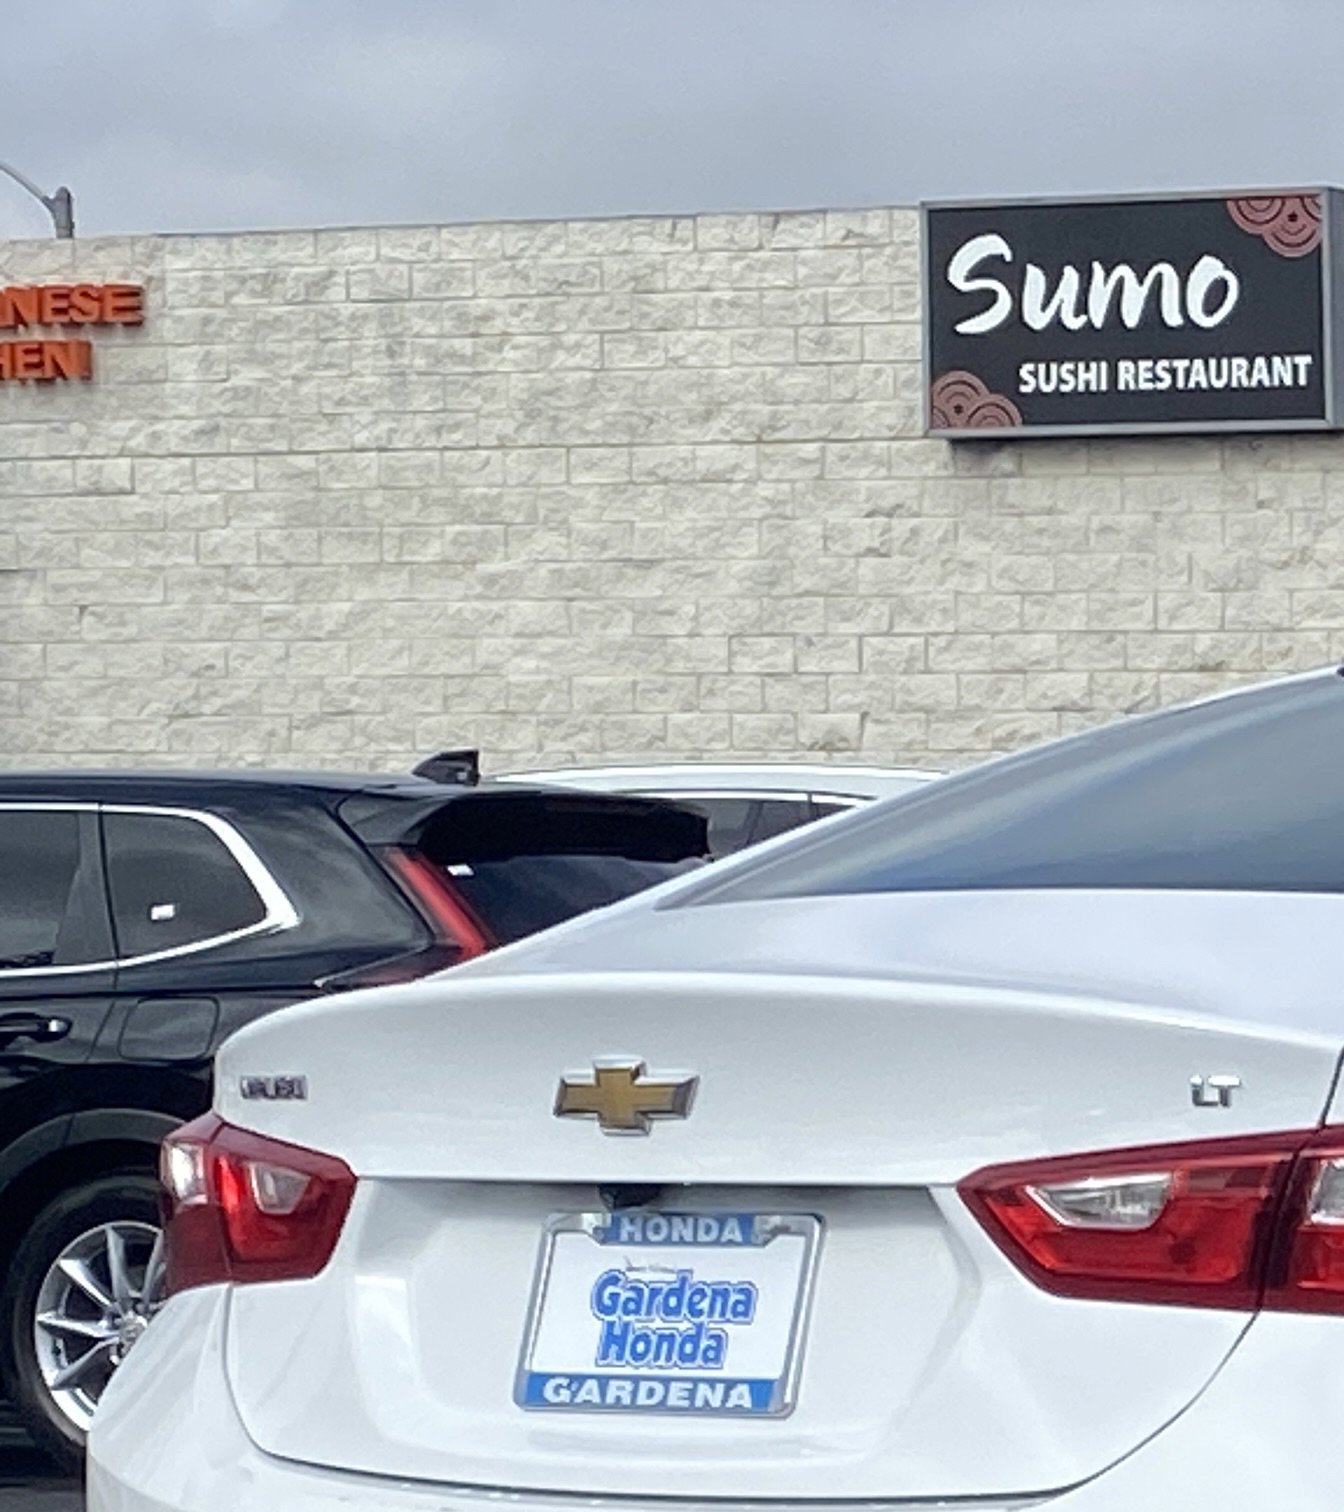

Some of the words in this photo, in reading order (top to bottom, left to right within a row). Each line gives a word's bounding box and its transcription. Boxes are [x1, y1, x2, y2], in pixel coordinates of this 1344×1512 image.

[947, 233, 1240, 334] Sumo
[1018, 360, 1108, 394] SUSHI
[1117, 355, 1314, 391] RESTAURANT
[1190, 1075, 1240, 1107] LT
[619, 1216, 744, 1243] HONDA
[592, 1270, 757, 1323] Gardena
[596, 1321, 728, 1369] Honda
[543, 1377, 752, 1408] GARDENA
